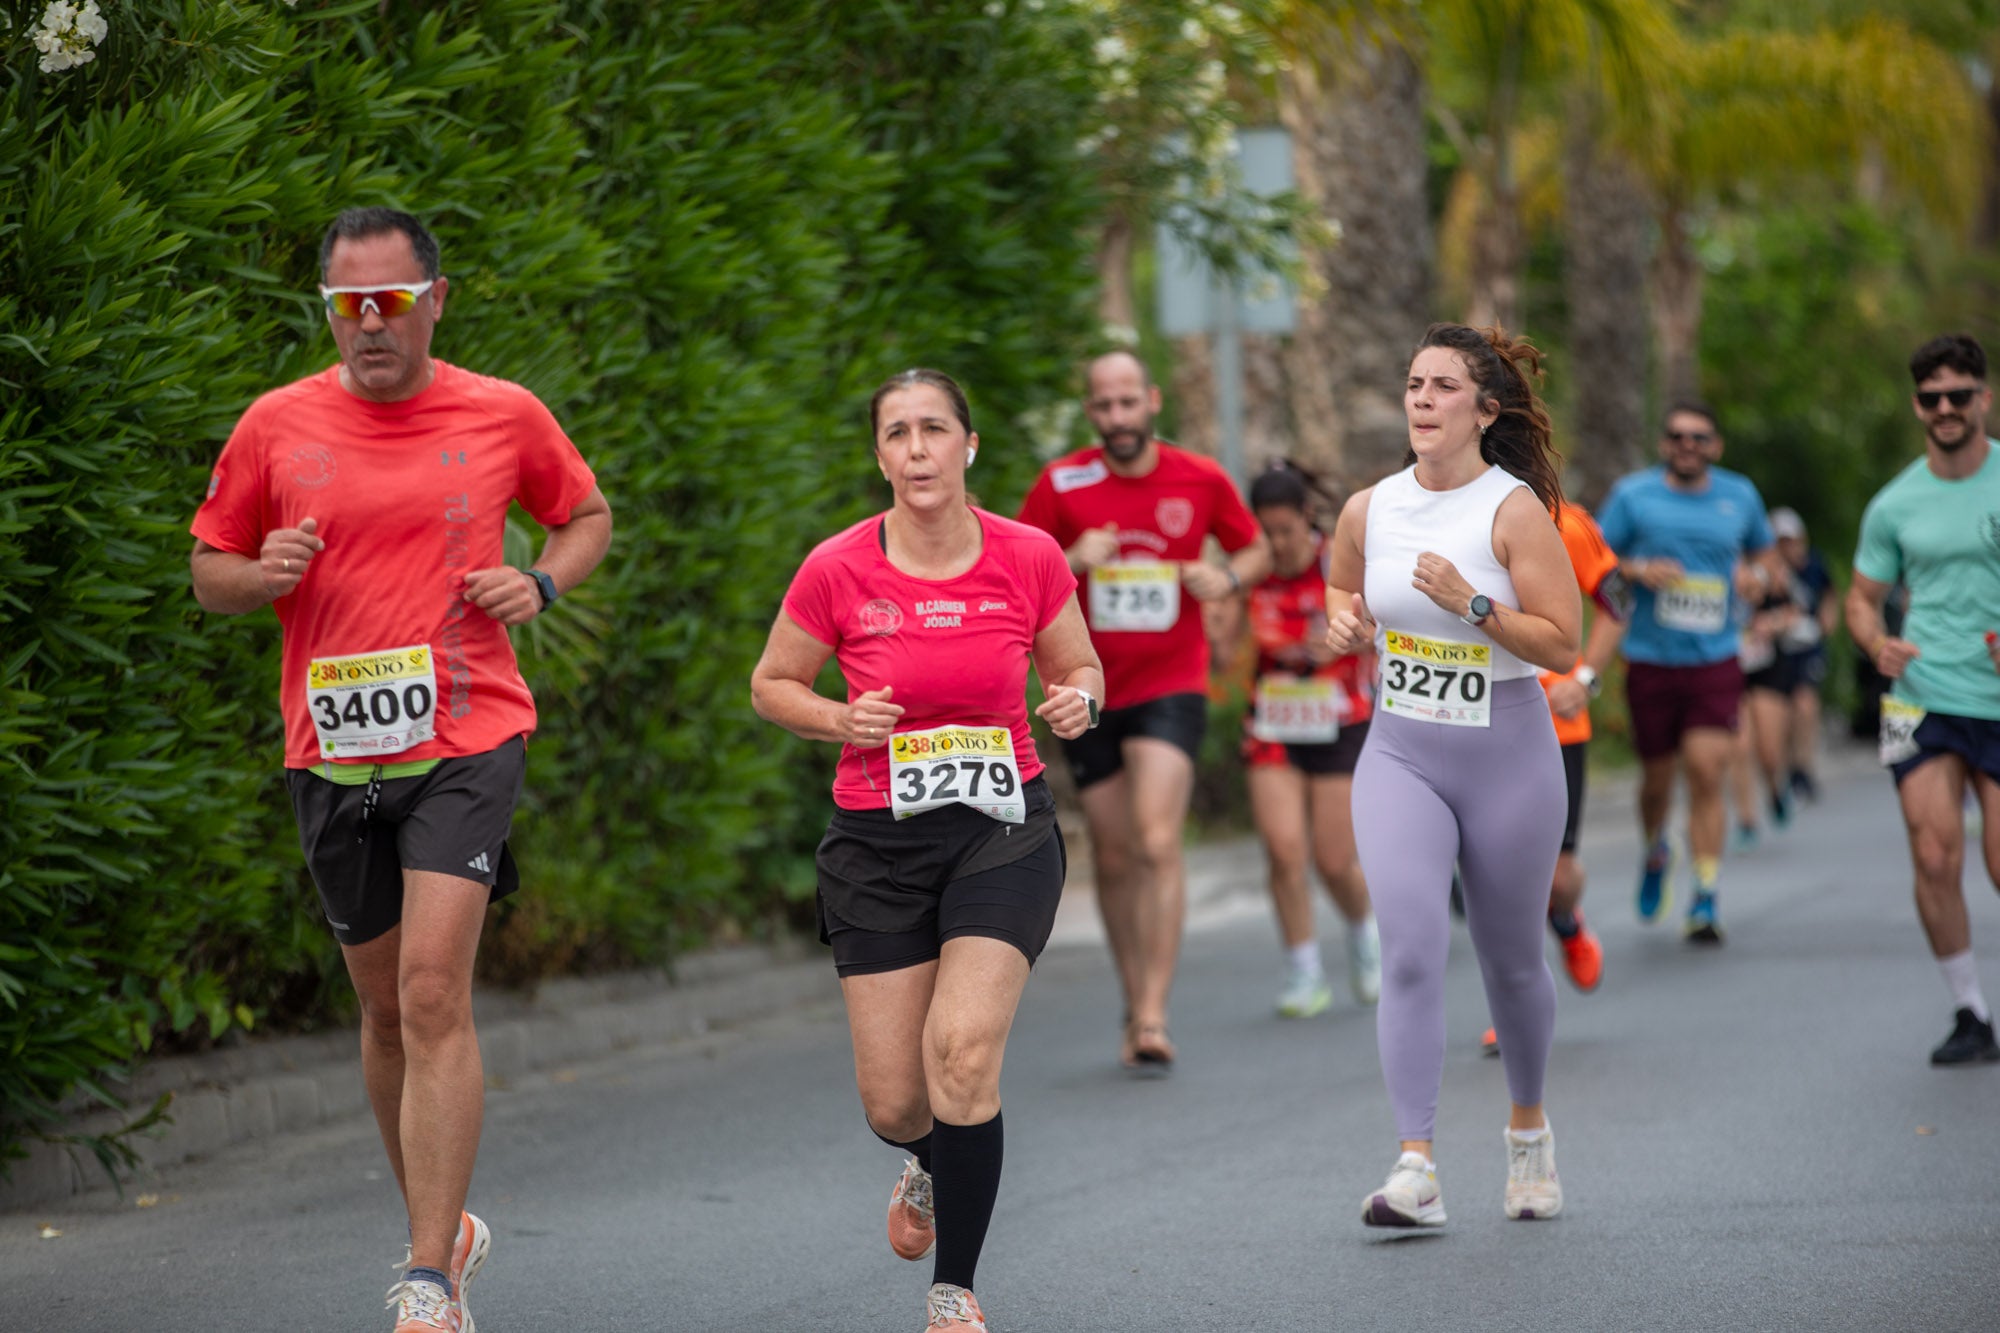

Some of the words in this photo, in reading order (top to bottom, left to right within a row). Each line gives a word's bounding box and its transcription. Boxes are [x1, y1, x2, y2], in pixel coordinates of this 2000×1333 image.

[915, 600, 967, 616] M.CARMEN
[923, 614, 962, 629] JÓDAR
[1399, 636, 1415, 653] 38
[1414, 643, 1467, 660] FONDO
[321, 664, 337, 681] 38
[337, 661, 404, 682] FONDO
[1386, 660, 1485, 703] 3270
[314, 683, 431, 731] 3400
[909, 737, 931, 755] 38
[933, 730, 955, 741] GRAN
[955, 730, 982, 738] PREMIO
[930, 736, 988, 754] FONDO
[897, 761, 1016, 803] 3279
